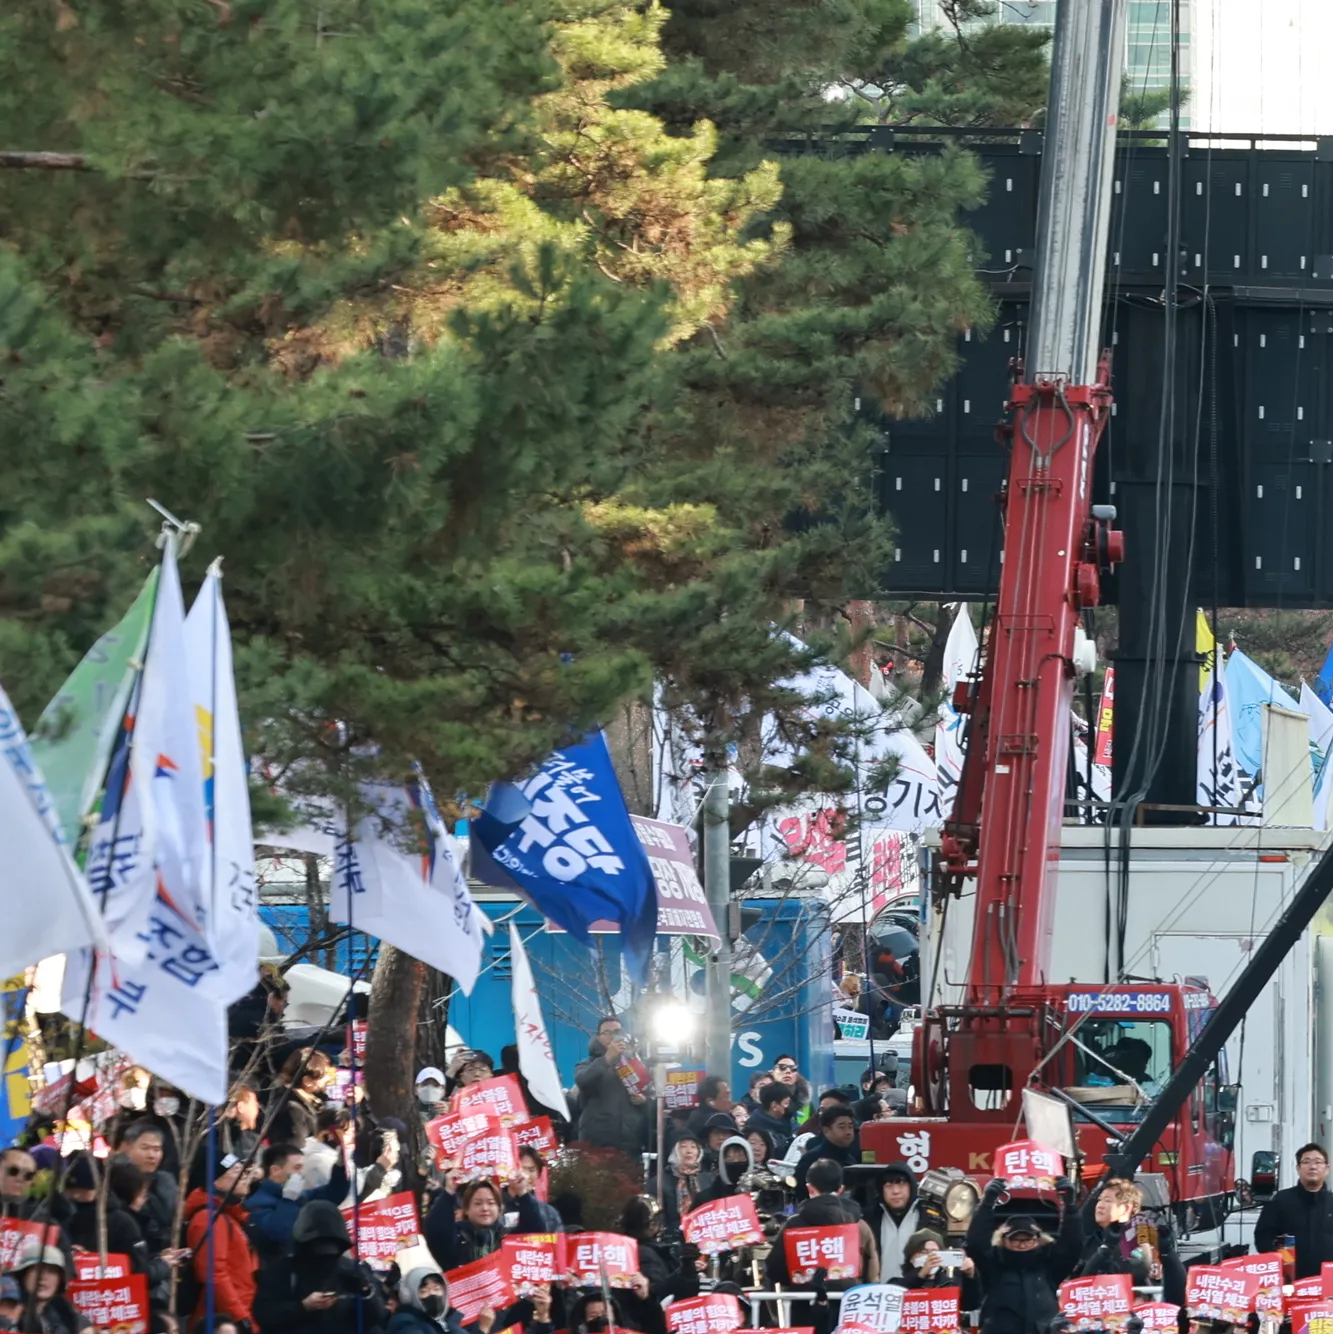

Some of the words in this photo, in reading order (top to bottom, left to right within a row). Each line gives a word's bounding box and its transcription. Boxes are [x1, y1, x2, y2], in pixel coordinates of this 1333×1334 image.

[896, 1130, 931, 1173] 형
[1005, 1148, 1054, 1174] 탄핵
[692, 1206, 742, 1228] 내란수괴
[577, 1244, 626, 1273] 탄핵
[796, 1236, 844, 1266] 탄핵
[1070, 1286, 1119, 1301] 내란수괴
[1195, 1274, 1245, 1295] 내란수괴
[841, 1288, 901, 1320] 윤석열
[930, 1300, 957, 1316] 힘으로
[930, 1314, 957, 1331] 지키자
